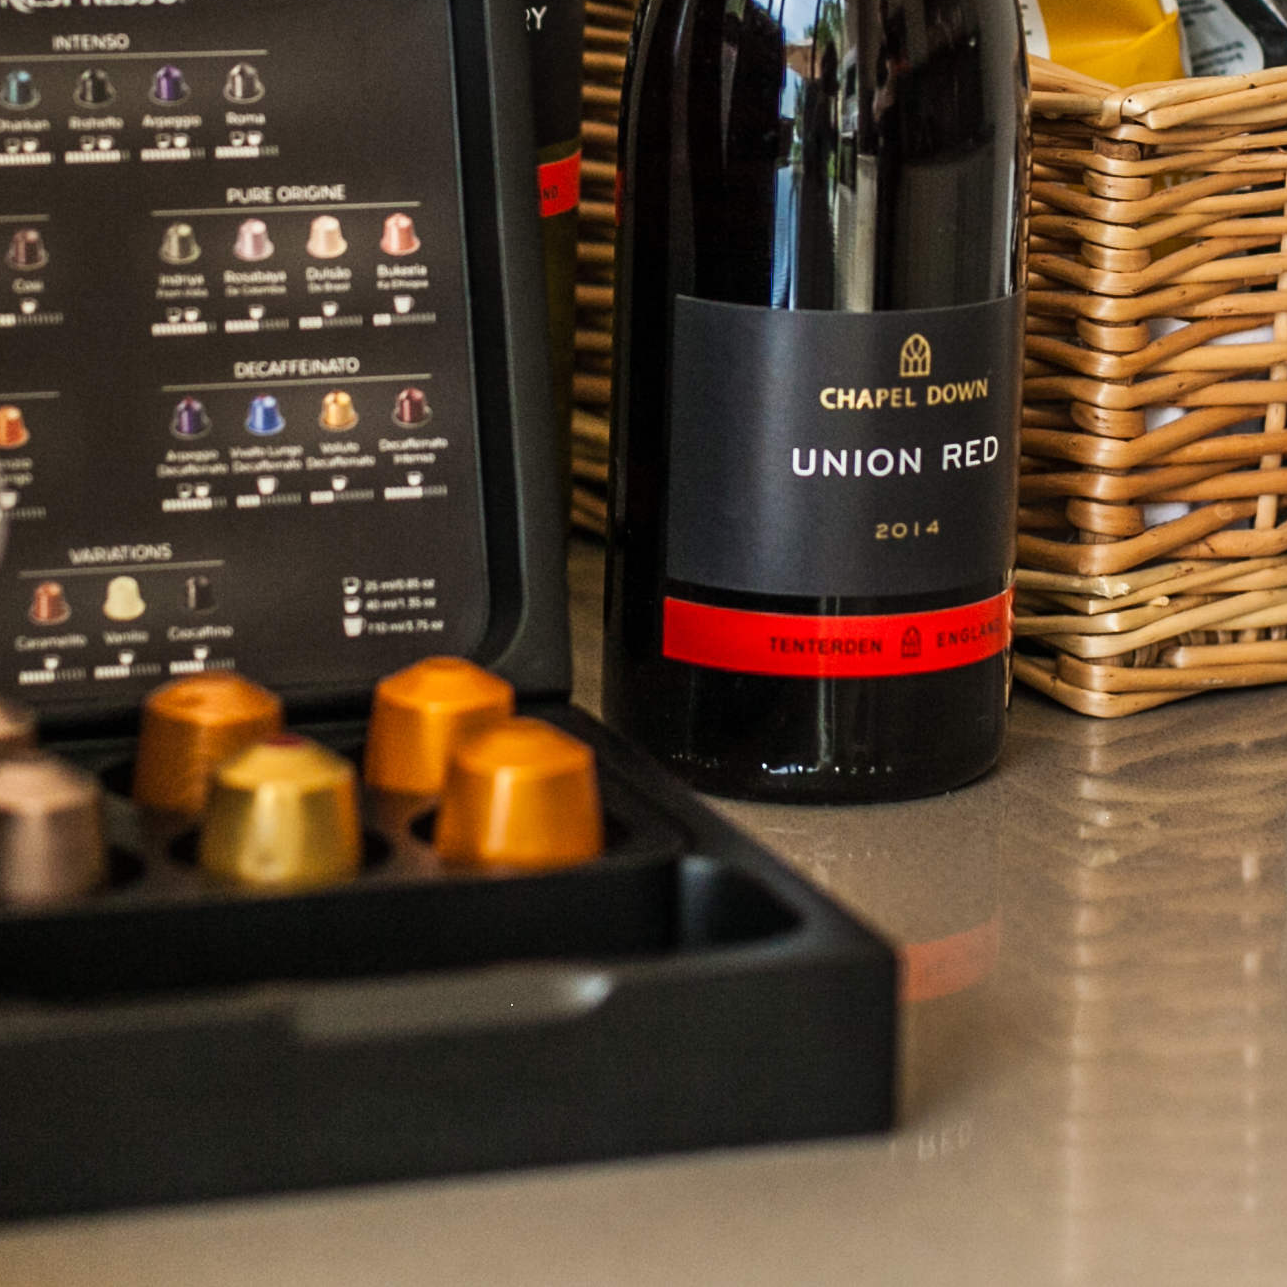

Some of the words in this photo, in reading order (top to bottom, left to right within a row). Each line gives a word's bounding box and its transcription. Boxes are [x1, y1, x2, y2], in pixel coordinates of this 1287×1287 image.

[52, 33, 130, 51] INTENSO
[225, 112, 265, 125] Roma
[226, 186, 274, 204] PURE
[276, 184, 346, 202] ORIGINE
[233, 356, 360, 379] DECAFFEINATO
[820, 387, 917, 410] CHAPEL
[927, 378, 988, 405] DOWN
[792, 447, 921, 477] UNION
[942, 436, 998, 470] RED
[875, 520, 939, 540] 2014
[68, 542, 173, 565] VARIATIONS
[770, 636, 882, 654] TENTERDEN
[936, 618, 1002, 647] ENGLAND
